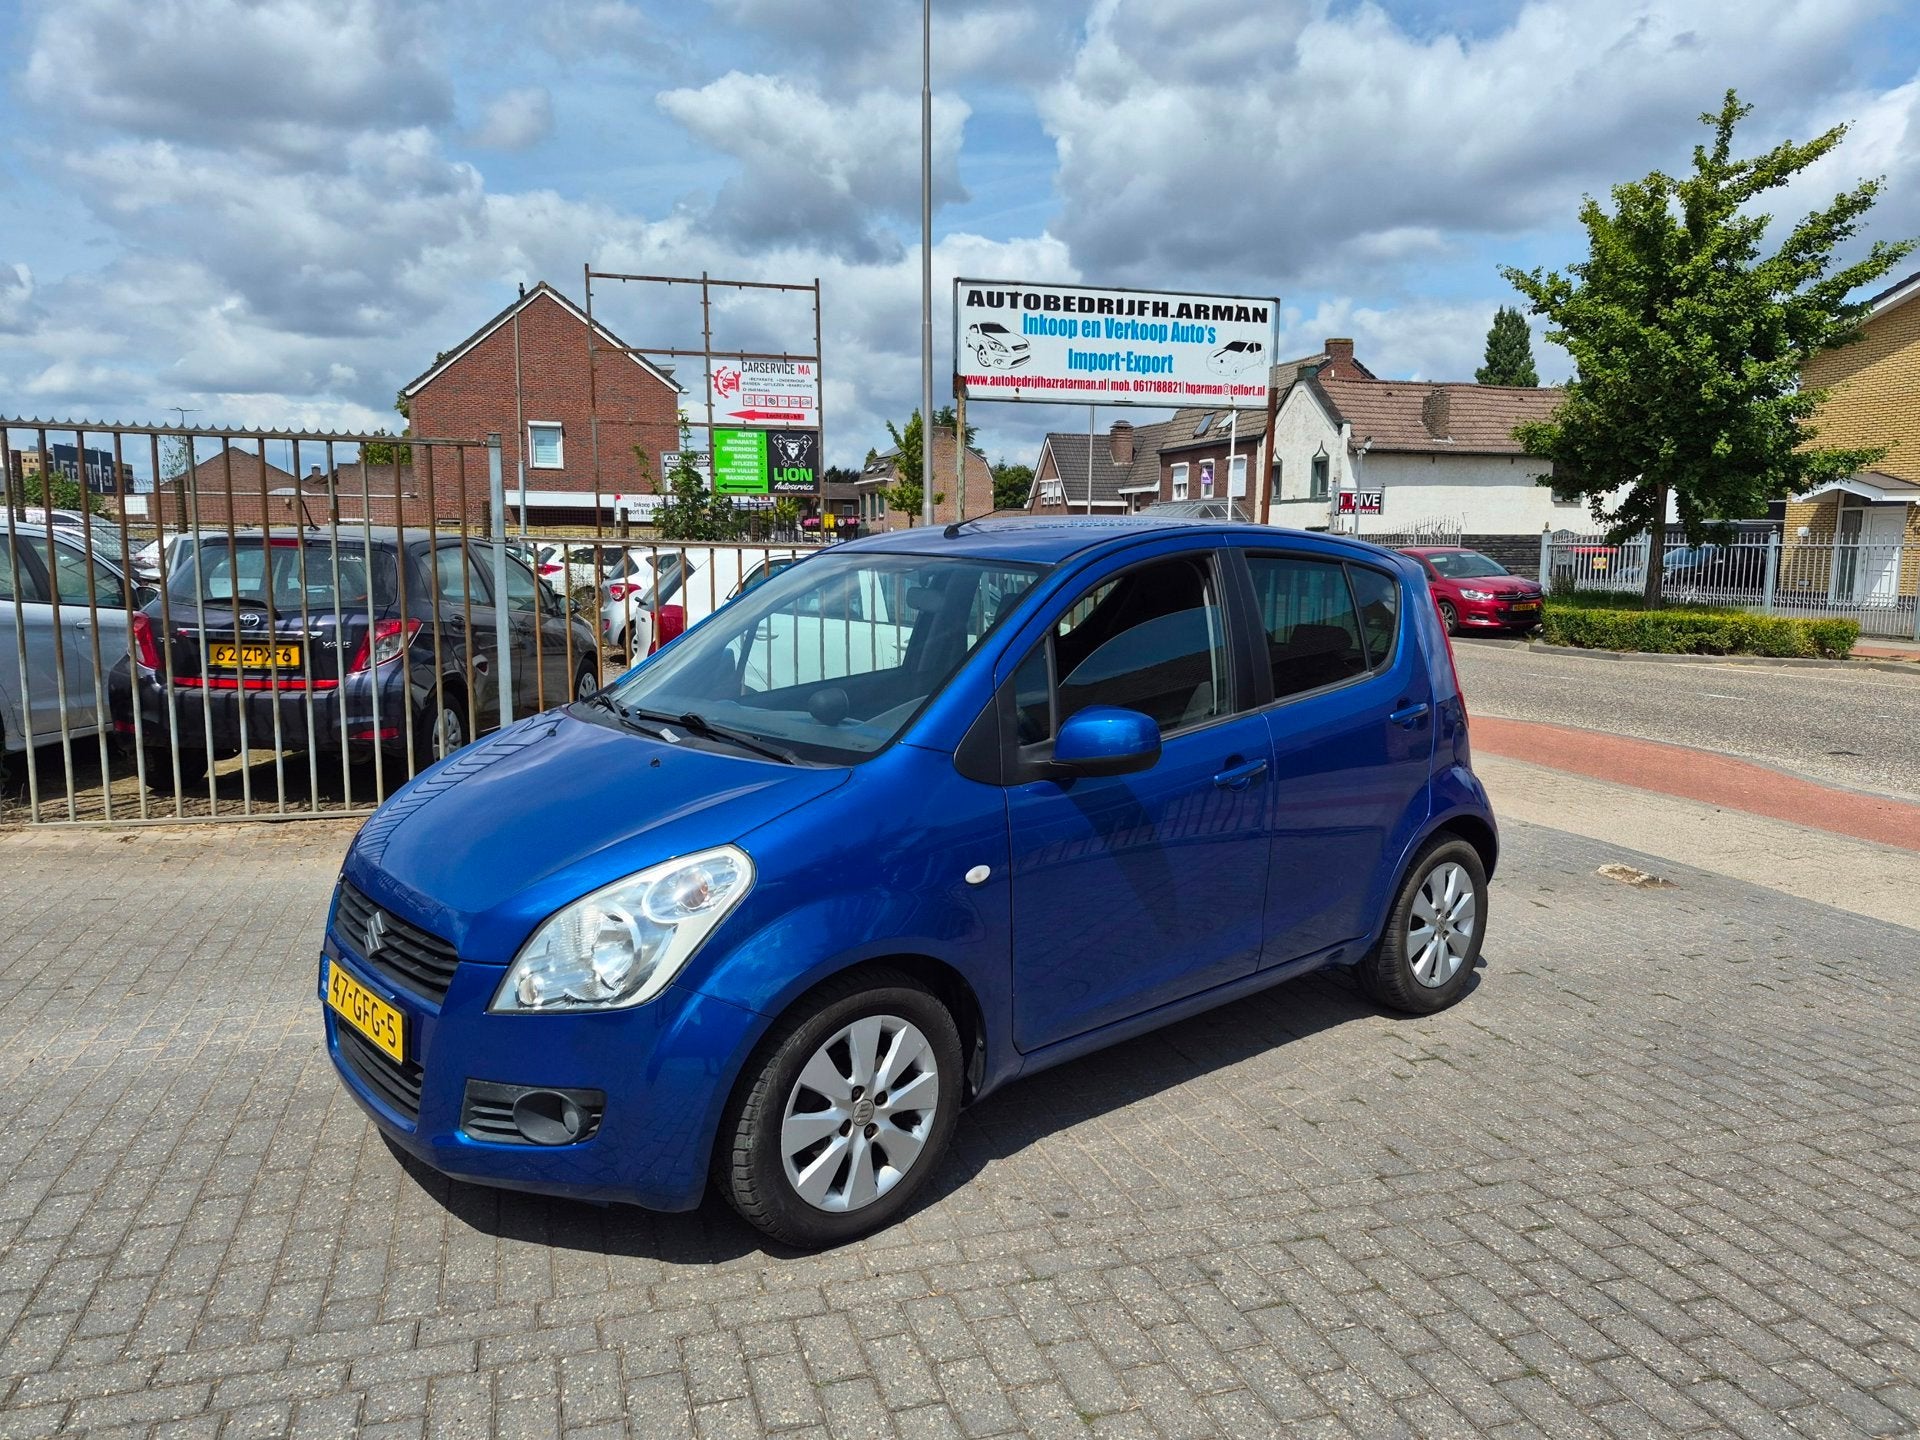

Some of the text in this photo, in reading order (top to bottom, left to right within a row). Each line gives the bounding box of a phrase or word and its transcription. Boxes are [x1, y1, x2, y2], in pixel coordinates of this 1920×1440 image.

[1023, 313, 1216, 344] Inkoop en Verkoop Auto's
[741, 361, 811, 375] CARSERVICE MA
[1068, 348, 1173, 375] Import-Export
[773, 467, 813, 482] LION
[333, 972, 396, 1048] 47-GFG-5
